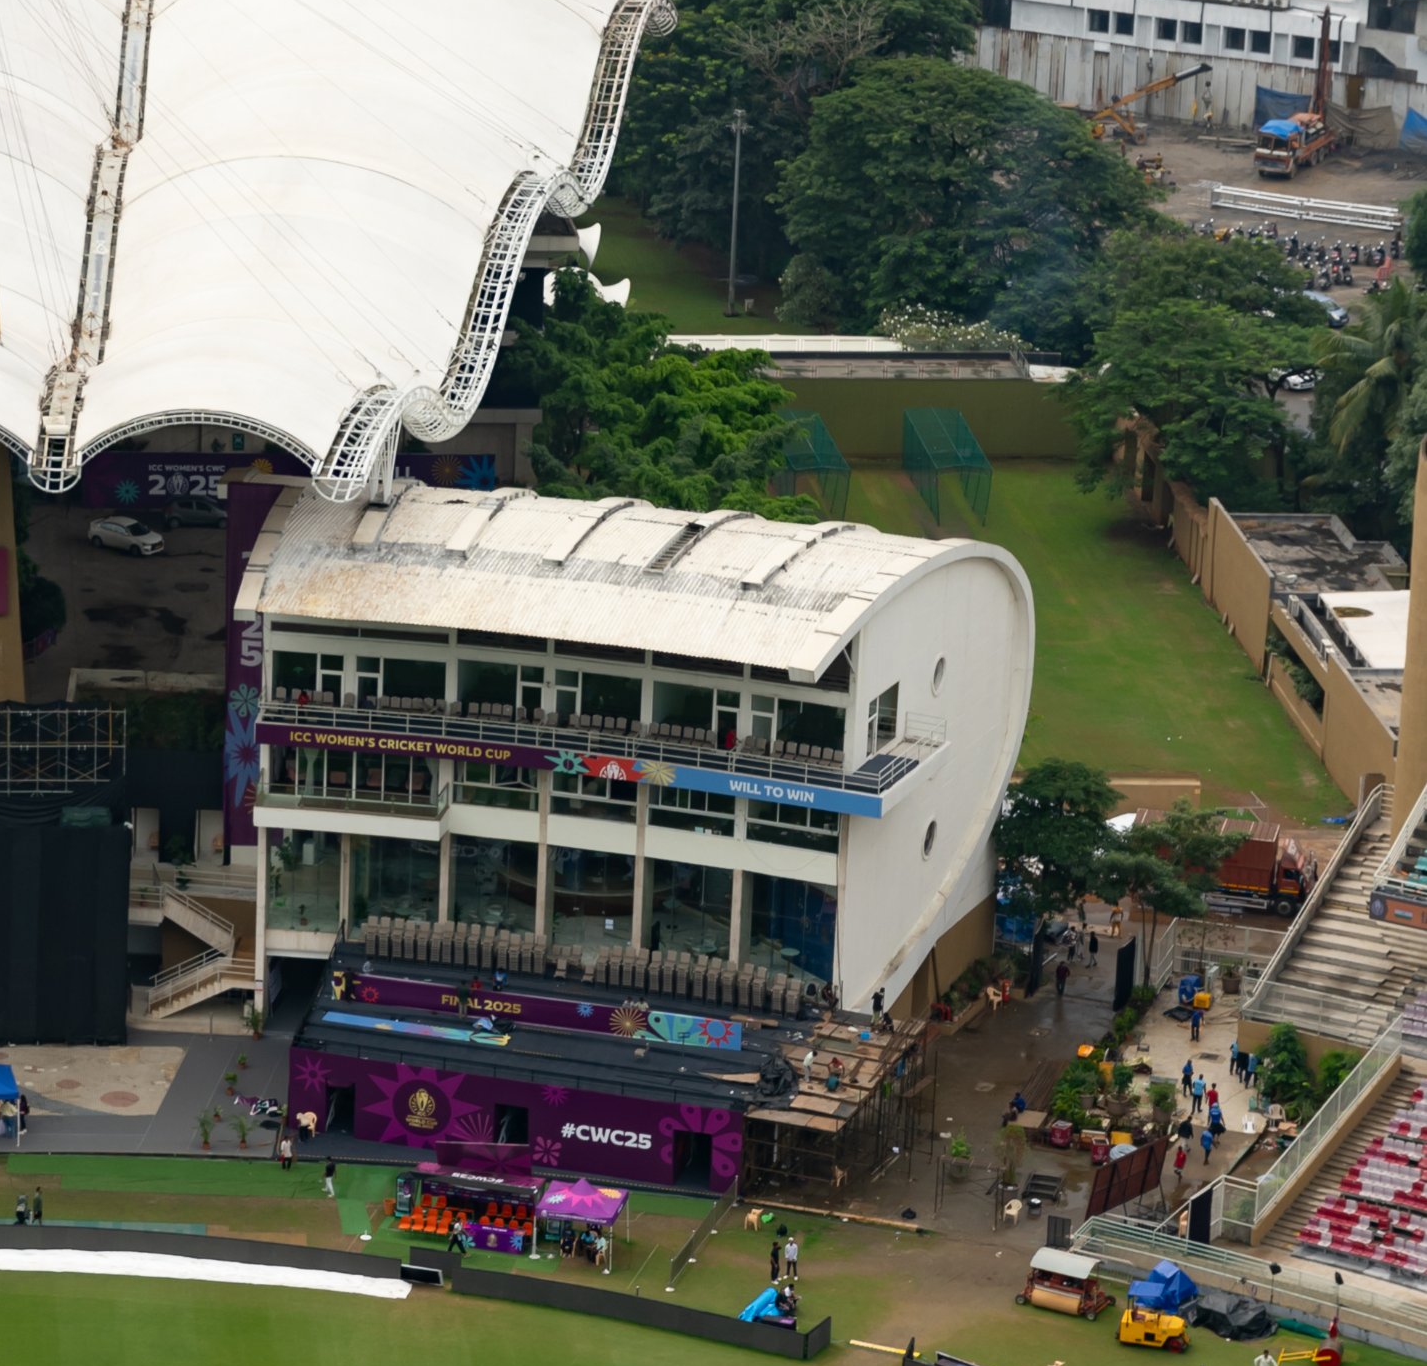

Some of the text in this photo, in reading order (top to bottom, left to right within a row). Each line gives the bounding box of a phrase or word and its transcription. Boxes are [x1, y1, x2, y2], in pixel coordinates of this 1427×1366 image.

[148, 464, 226, 473] ICC WOMEN'S CWC
[290, 731, 511, 760] ICC WOMEN'S CRICKET WORLD CUP
[729, 780, 815, 804] WILL TO WIN
[484, 999, 522, 1014] 2025
[561, 1122, 653, 1150] #CWC25
